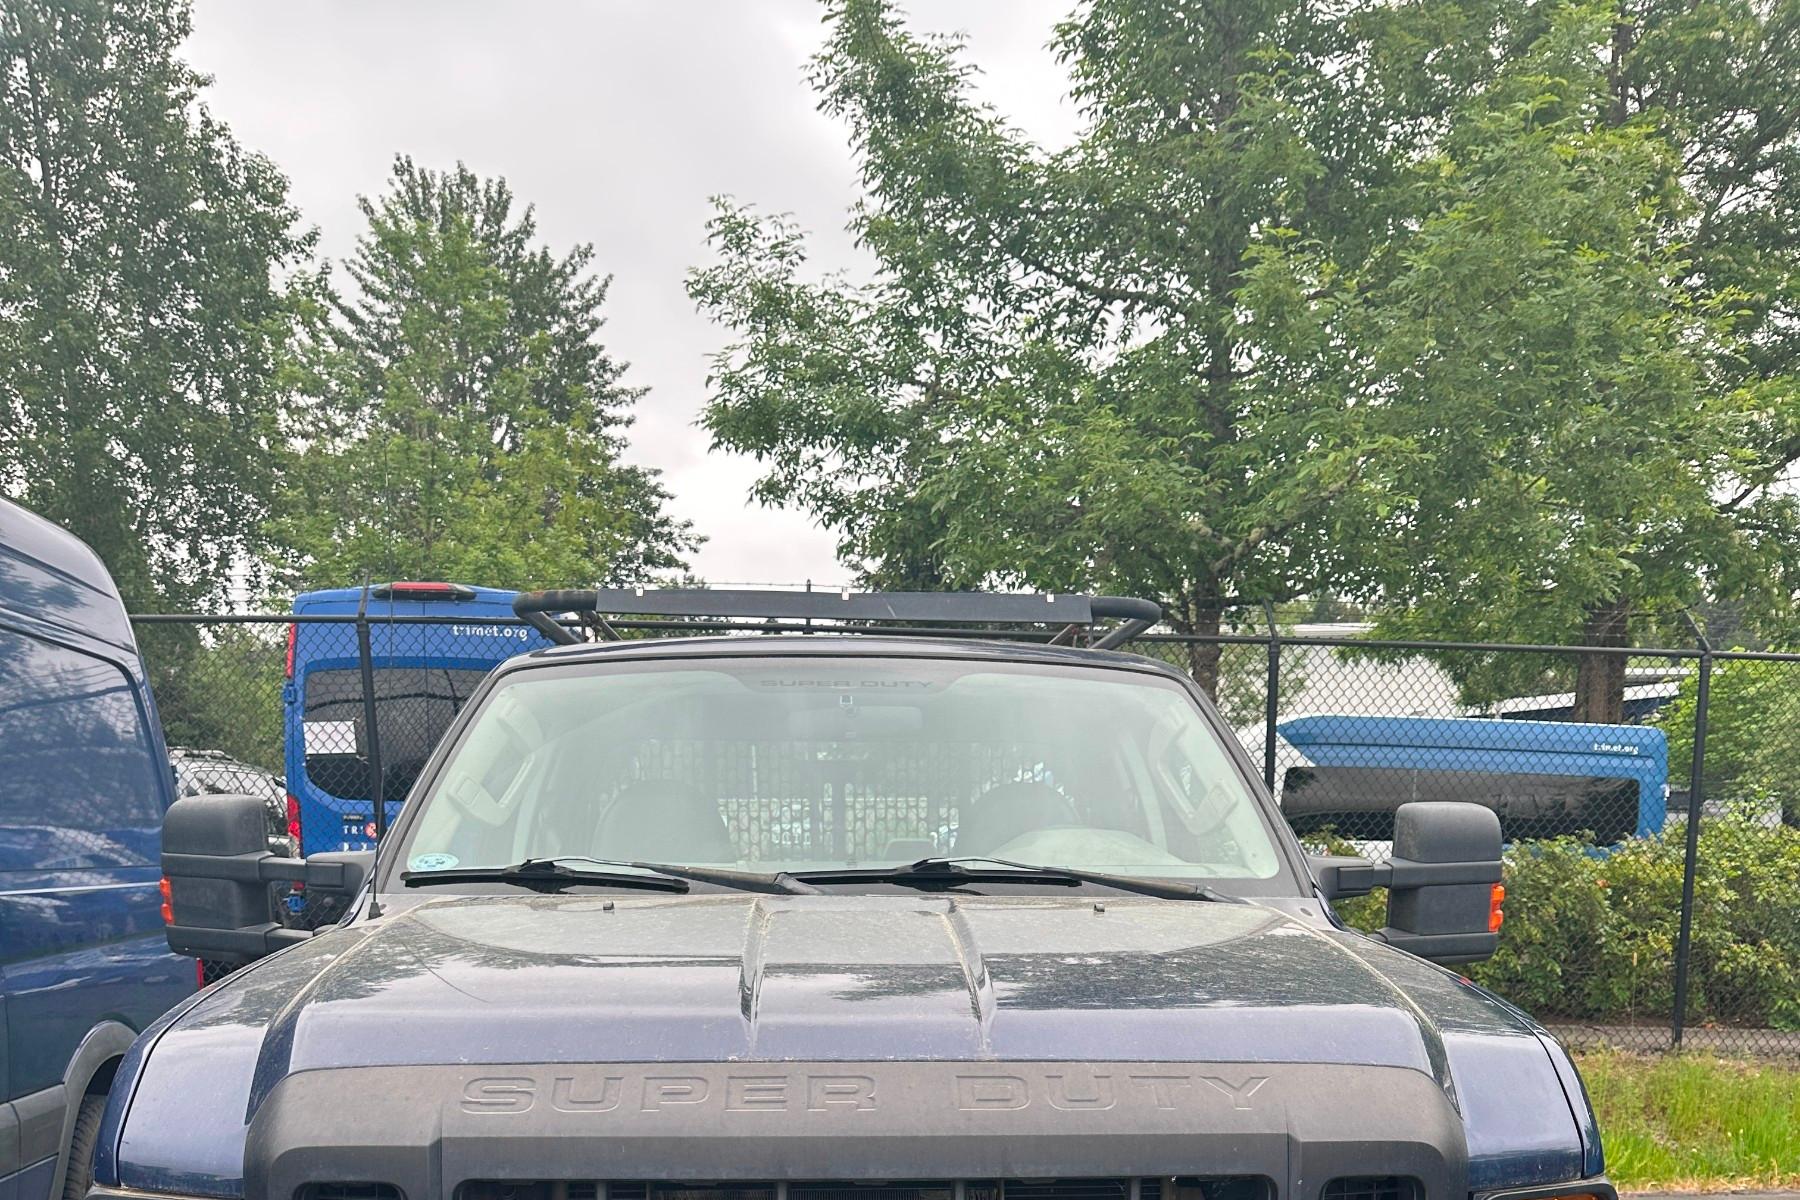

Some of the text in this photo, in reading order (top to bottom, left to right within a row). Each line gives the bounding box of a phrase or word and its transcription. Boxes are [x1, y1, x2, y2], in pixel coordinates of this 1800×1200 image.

[760, 679, 934, 689] SUPER DUTY
[461, 1075, 1271, 1115] SUPER DUTY
